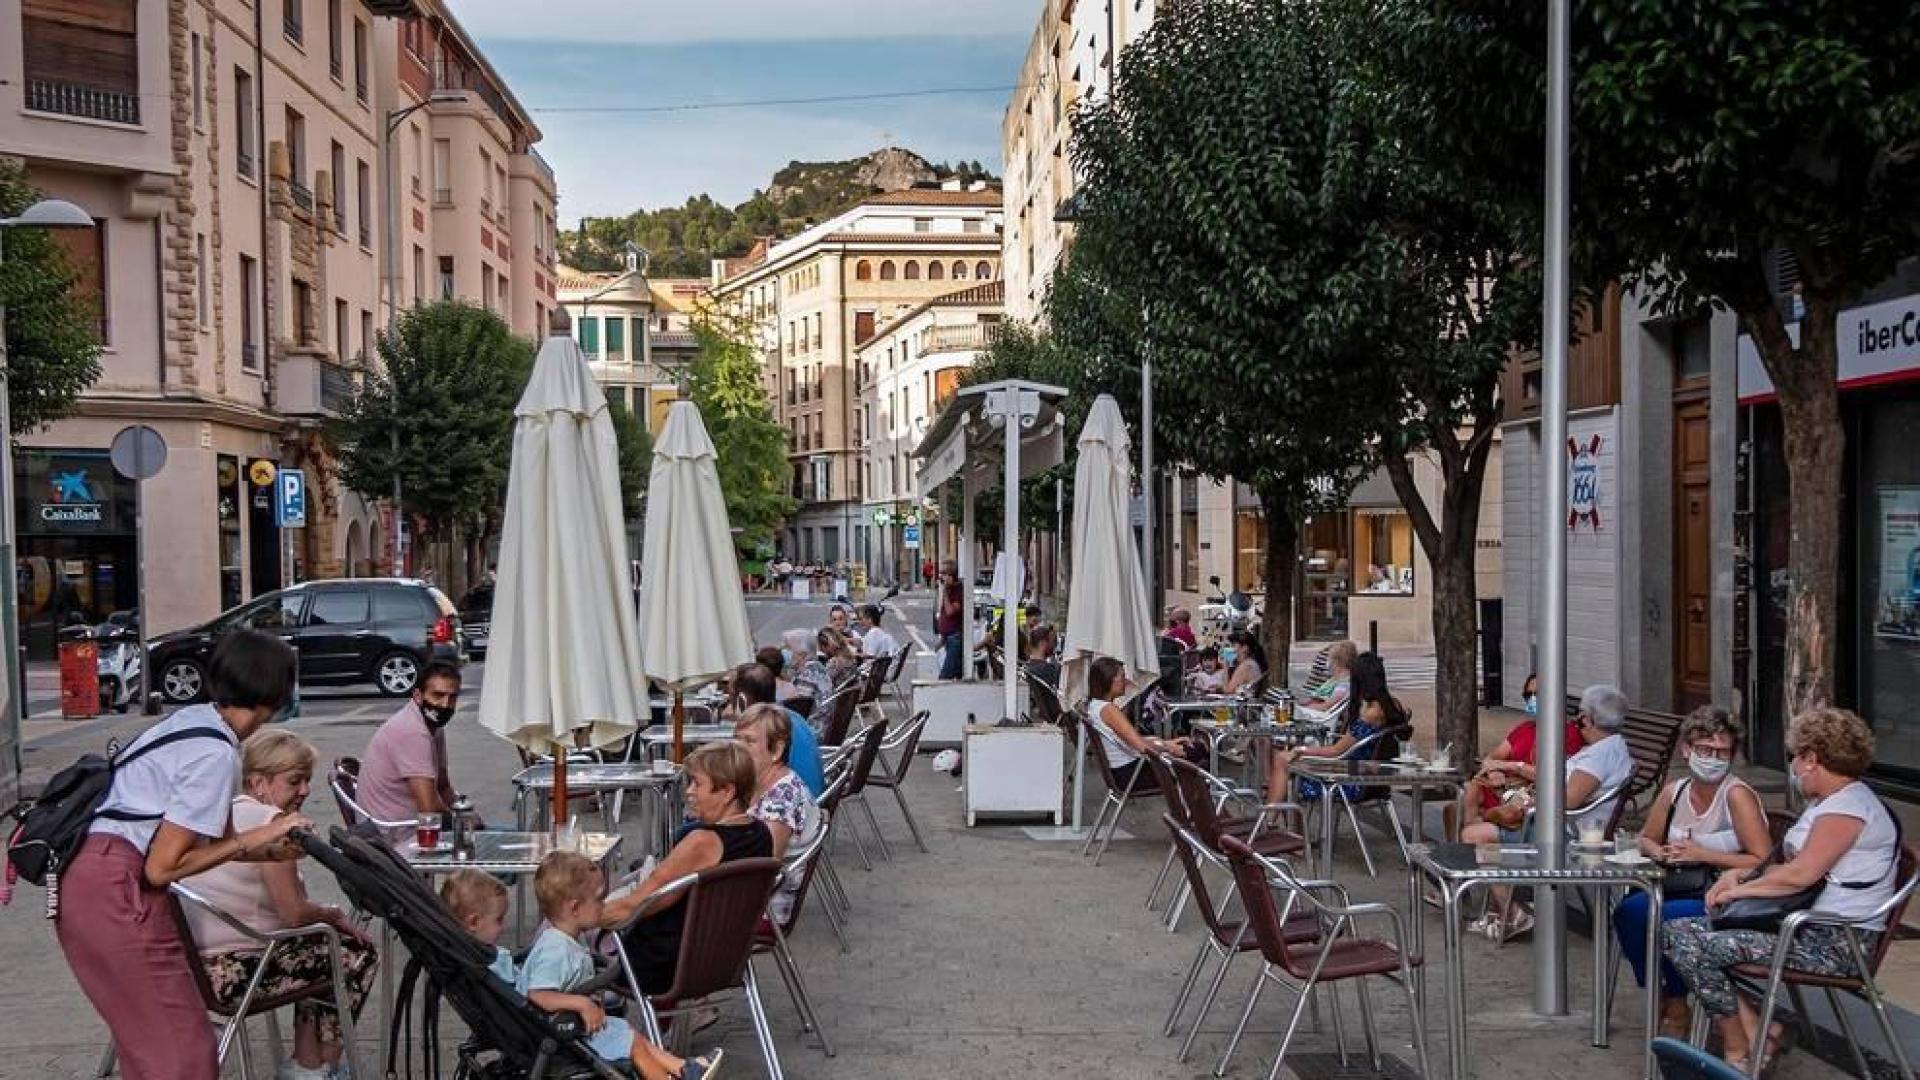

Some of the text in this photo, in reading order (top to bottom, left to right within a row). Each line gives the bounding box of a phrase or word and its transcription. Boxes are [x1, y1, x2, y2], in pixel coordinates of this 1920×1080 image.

[1858, 312, 1920, 354] iberC
[285, 476, 299, 504] P
[41, 507, 101, 520] CaixaBank
